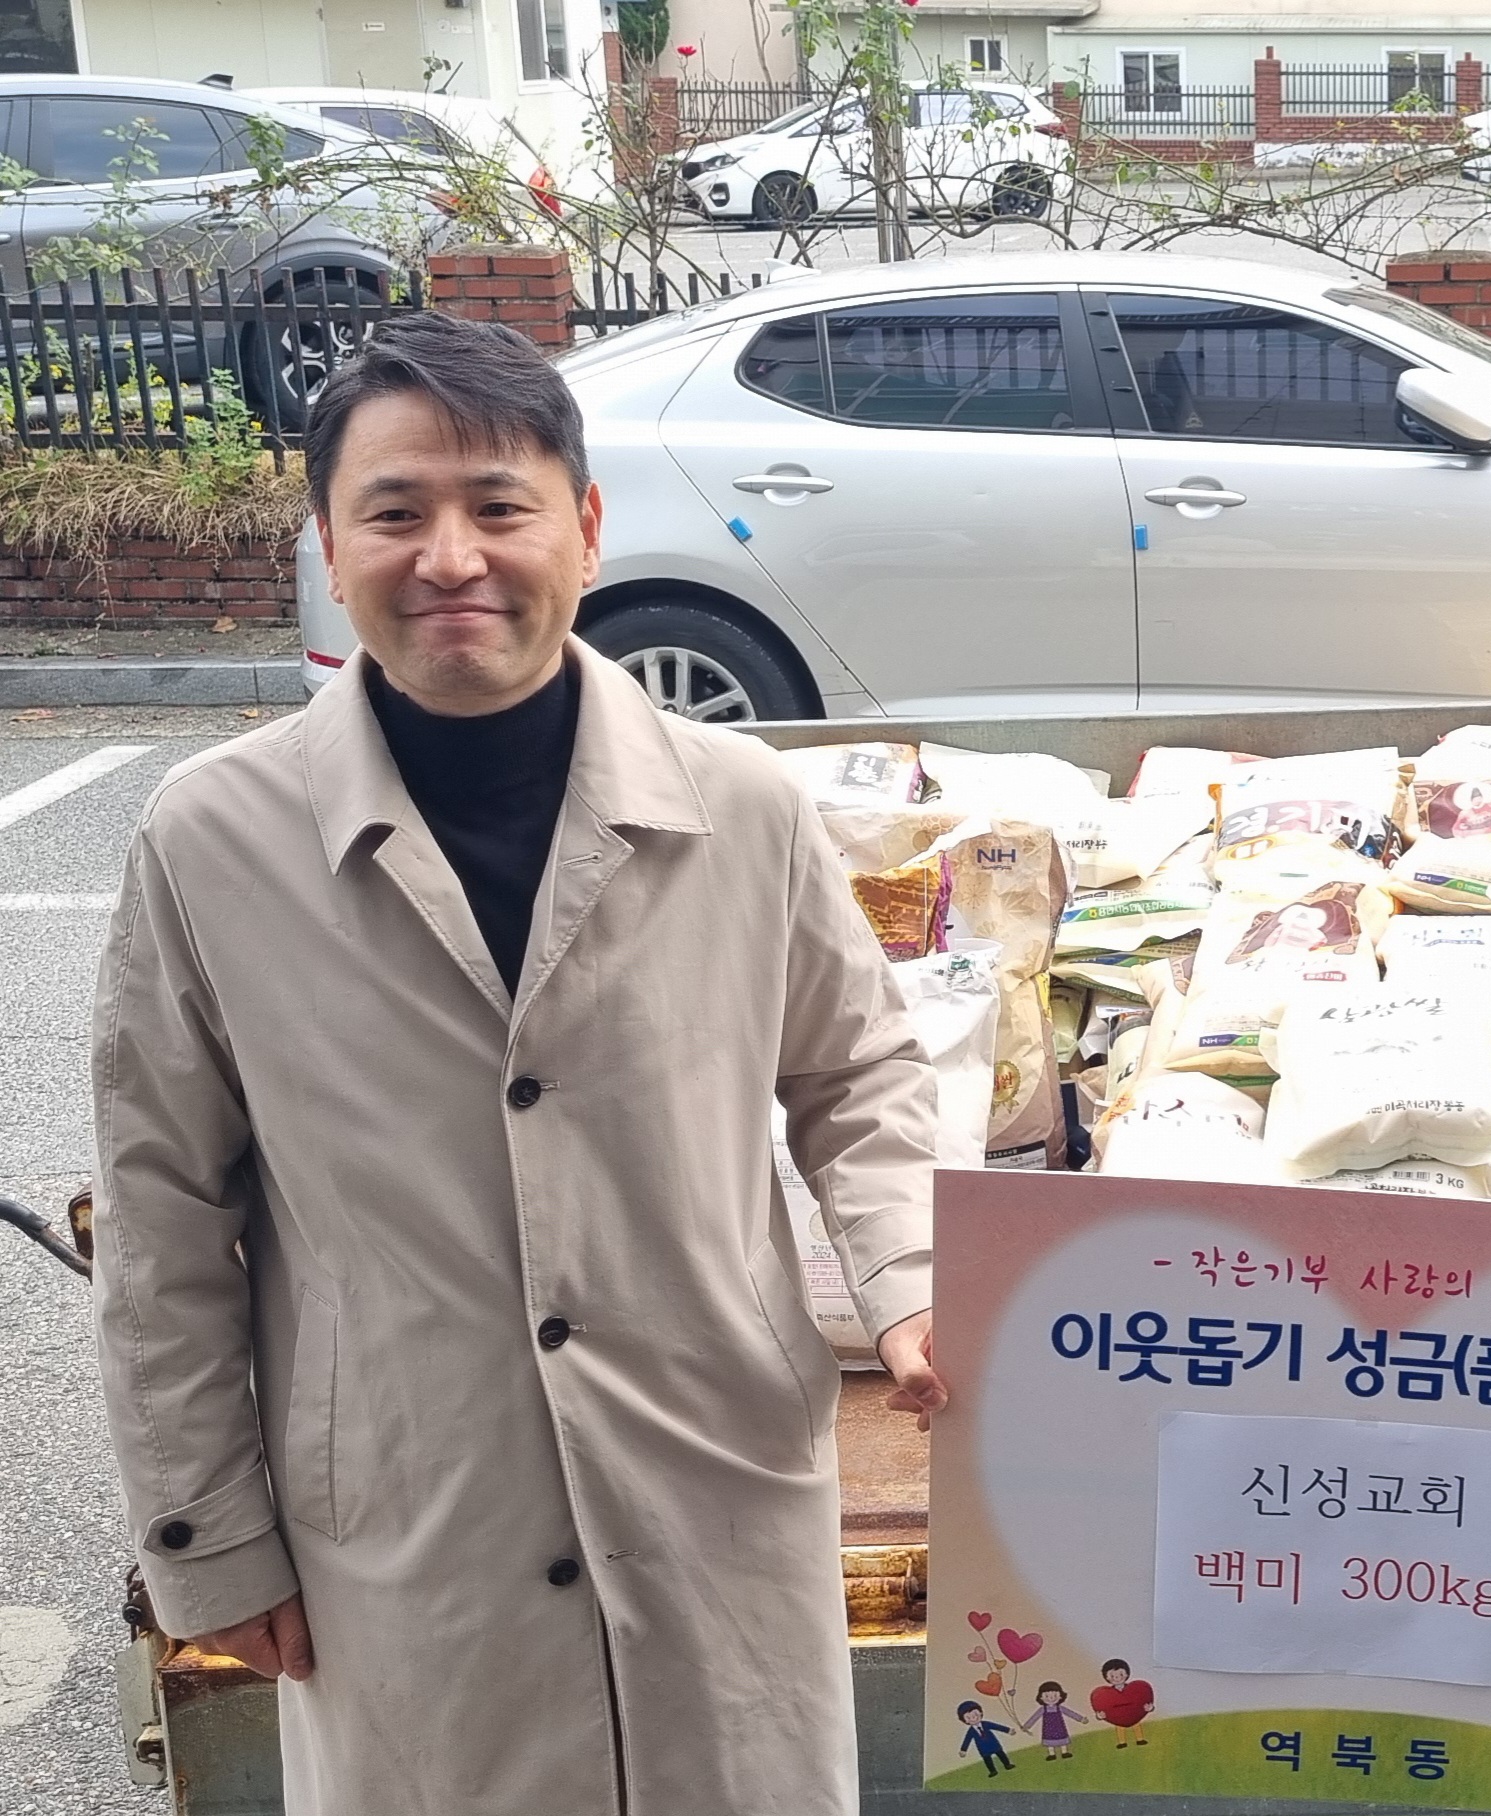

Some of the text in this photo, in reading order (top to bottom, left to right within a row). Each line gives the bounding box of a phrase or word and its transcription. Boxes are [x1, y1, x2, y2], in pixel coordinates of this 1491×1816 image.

[976, 848, 1016, 863] NH
[1435, 1172, 1464, 1189] 3 KG
[1191, 1246, 1331, 1293] 작은기부
[1360, 1261, 1473, 1300] 사랑의
[1051, 1311, 1303, 1387] 이웃돕기
[1241, 1464, 1466, 1529] 신성교회
[1193, 1550, 1302, 1606] 백미
